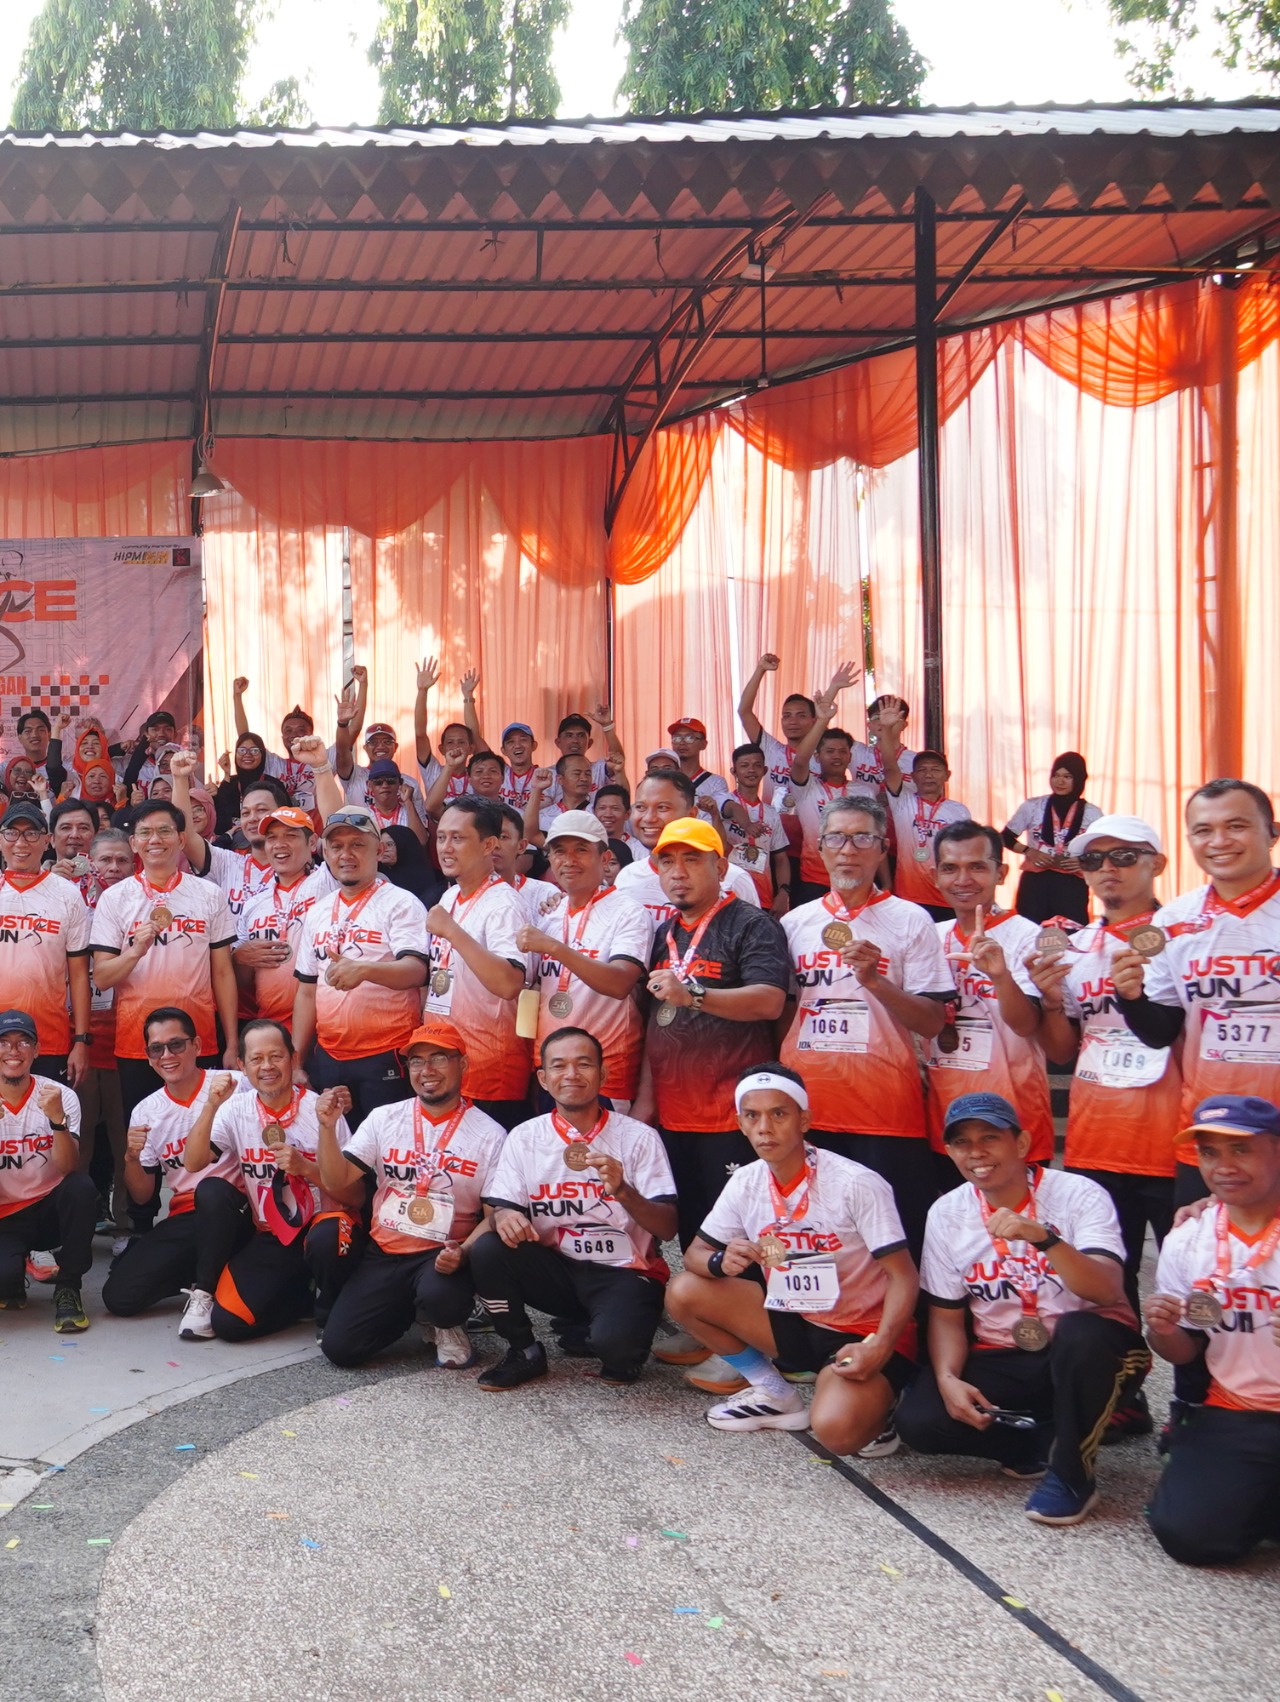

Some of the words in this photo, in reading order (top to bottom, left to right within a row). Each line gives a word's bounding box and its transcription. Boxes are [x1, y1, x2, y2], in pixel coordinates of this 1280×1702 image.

[823, 928, 848, 941] 10K
[1038, 936, 1062, 947] 10K
[812, 1019, 849, 1035] 1064
[1217, 1024, 1272, 1042] 5377
[412, 1206, 428, 1217] 5K
[531, 1200, 584, 1218] RUN
[574, 1240, 614, 1254] 5648
[785, 1275, 820, 1291] 1031
[1188, 1305, 1215, 1318] 5K
[1019, 1329, 1040, 1341] 5K
